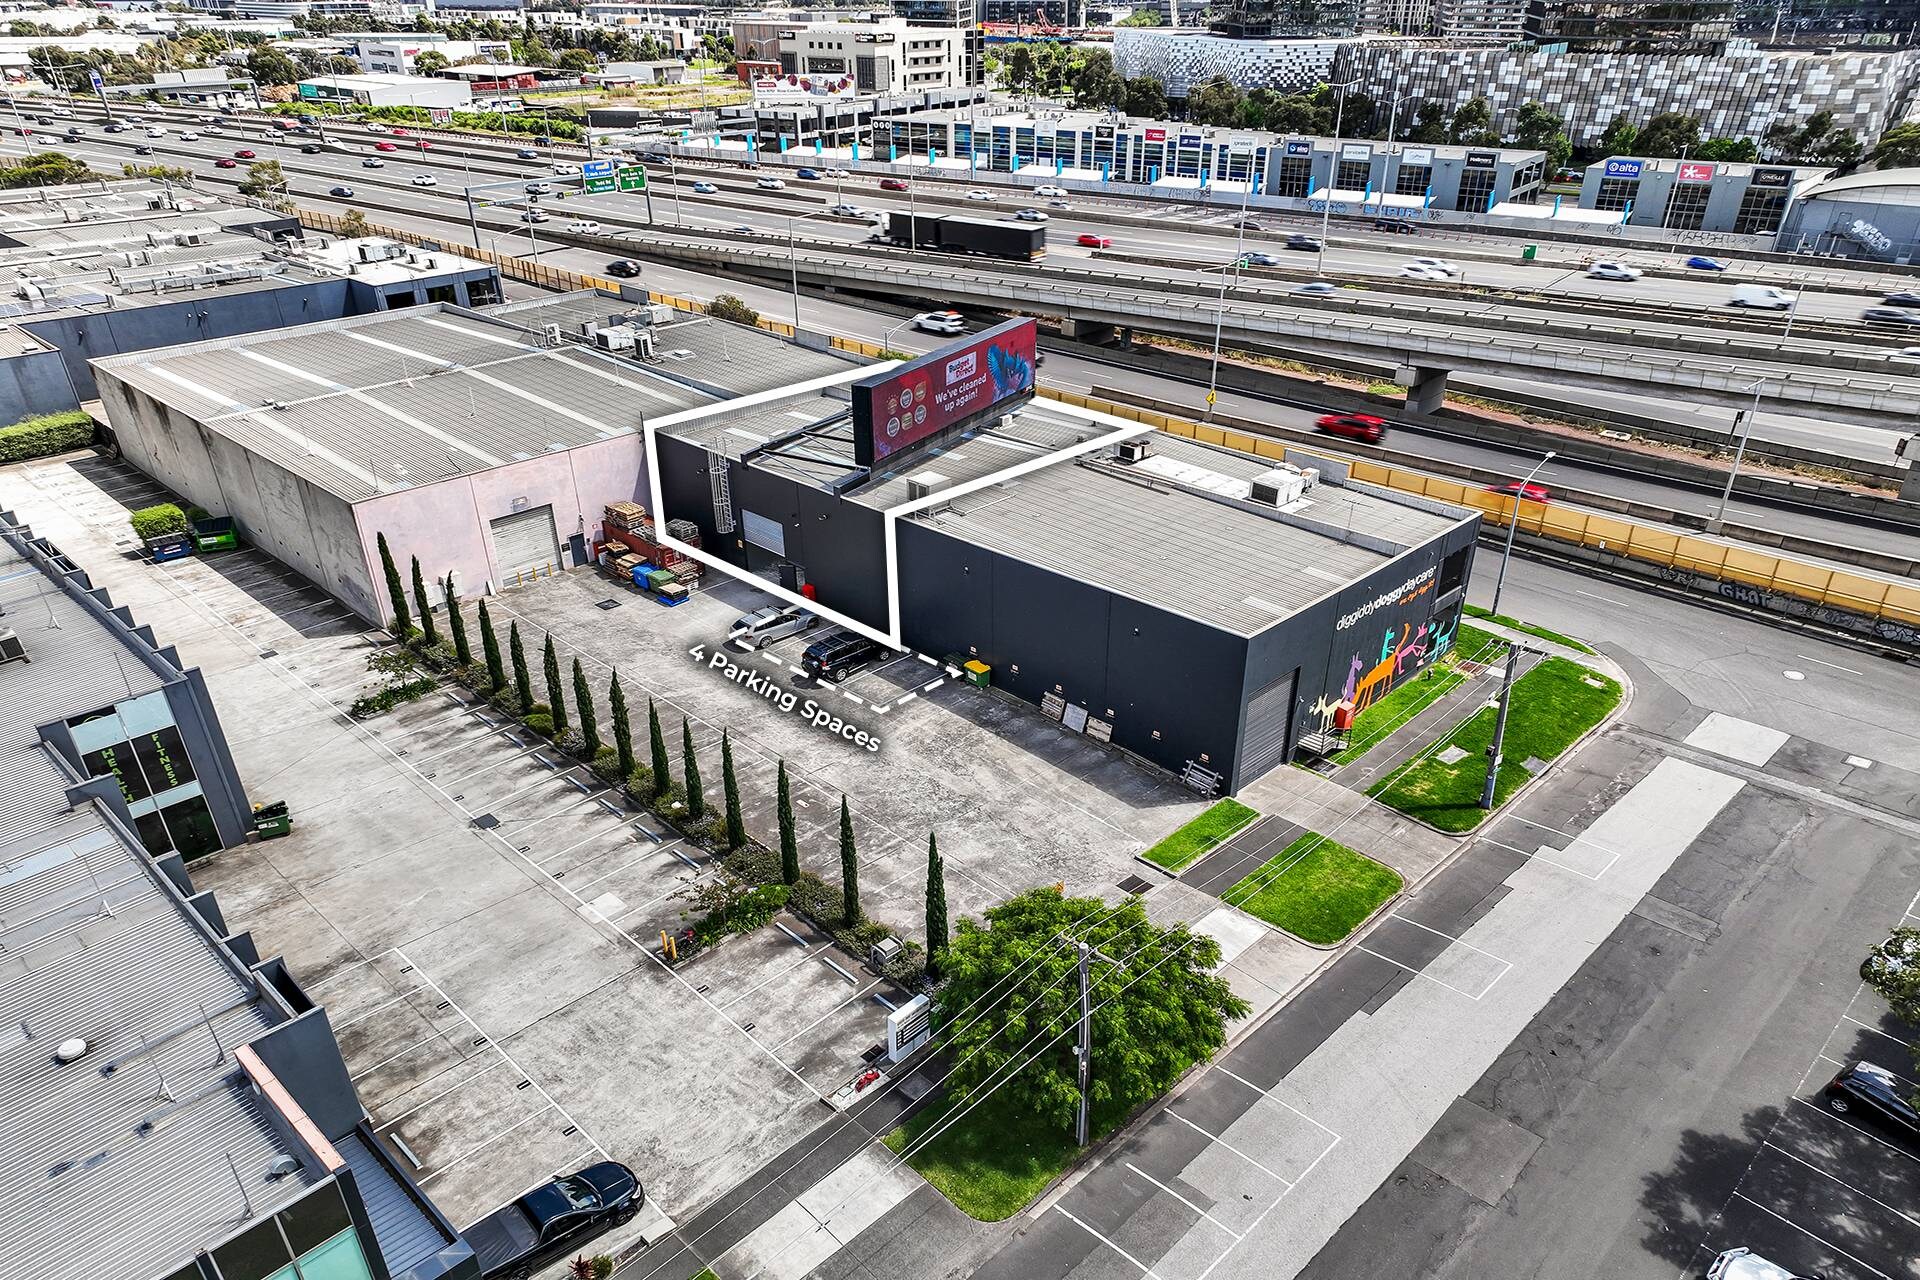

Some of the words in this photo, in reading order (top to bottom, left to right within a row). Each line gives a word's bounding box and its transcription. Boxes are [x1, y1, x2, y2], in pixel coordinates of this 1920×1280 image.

[1619, 163, 1639, 173] alta
[949, 358, 970, 373] Budget
[956, 364, 974, 377] Direct
[935, 389, 958, 405] We've
[959, 373, 987, 394] cleaned
[945, 401, 955, 411] up
[956, 388, 978, 407] again!
[151, 733, 178, 786] FITNESS
[101, 748, 134, 803] HEALTH
